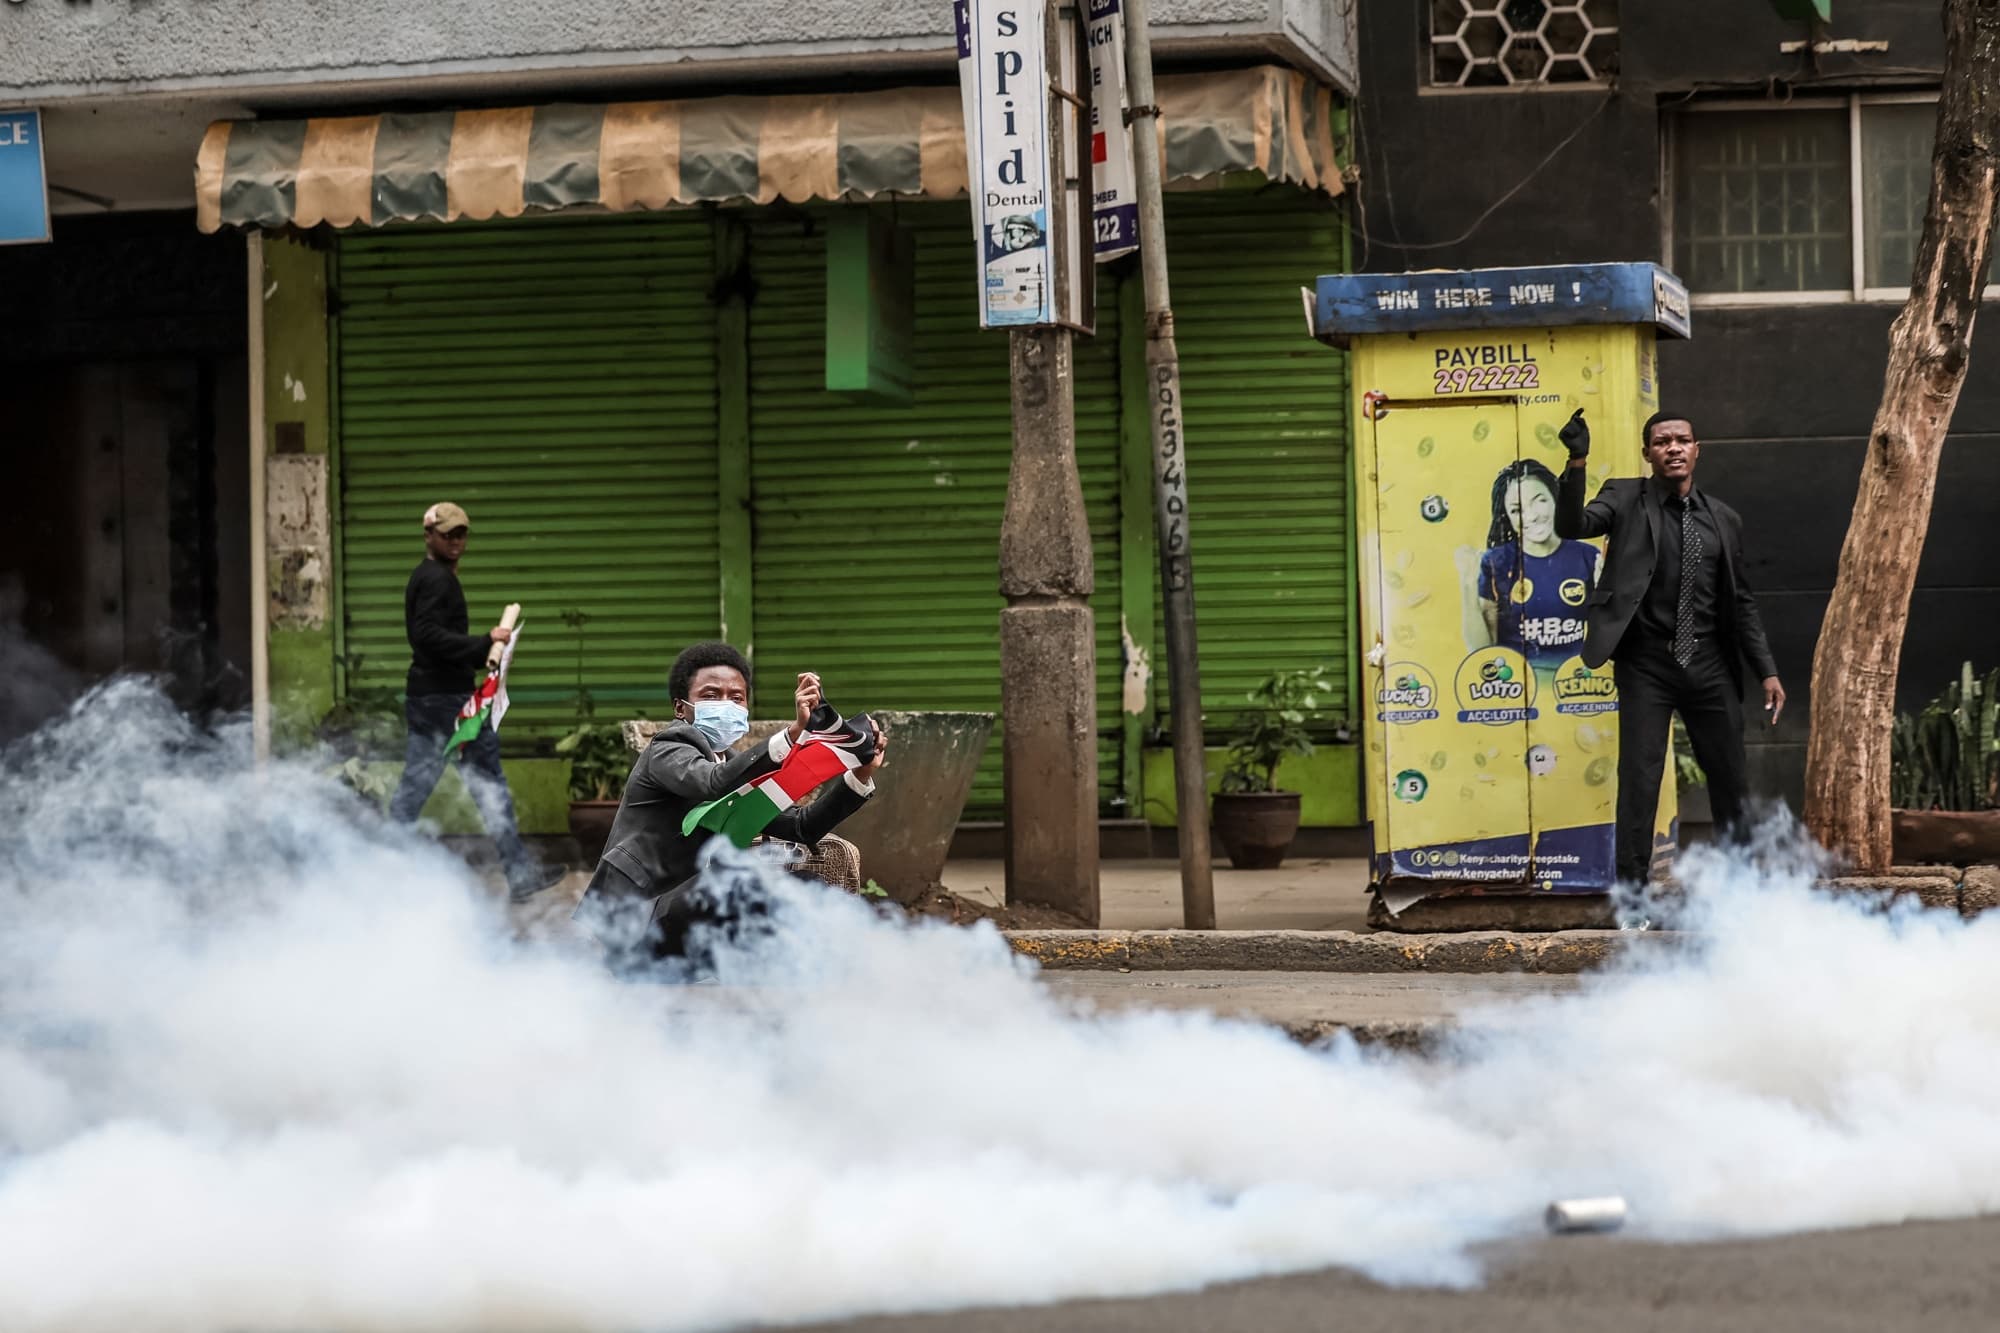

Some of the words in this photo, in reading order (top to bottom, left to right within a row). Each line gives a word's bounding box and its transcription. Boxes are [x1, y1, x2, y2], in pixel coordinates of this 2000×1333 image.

[987, 191, 1043, 207] Dental
[1376, 289, 1419, 310] WIN
[1435, 287, 1492, 309] HERE
[1510, 284, 1555, 305] NOW
[1435, 343, 1536, 368] PAYBILL
[1434, 363, 1539, 395] 292222
[1469, 679, 1523, 701] LOTTO
[1555, 676, 1615, 699] KENNO
[1409, 781, 1418, 792] 5
